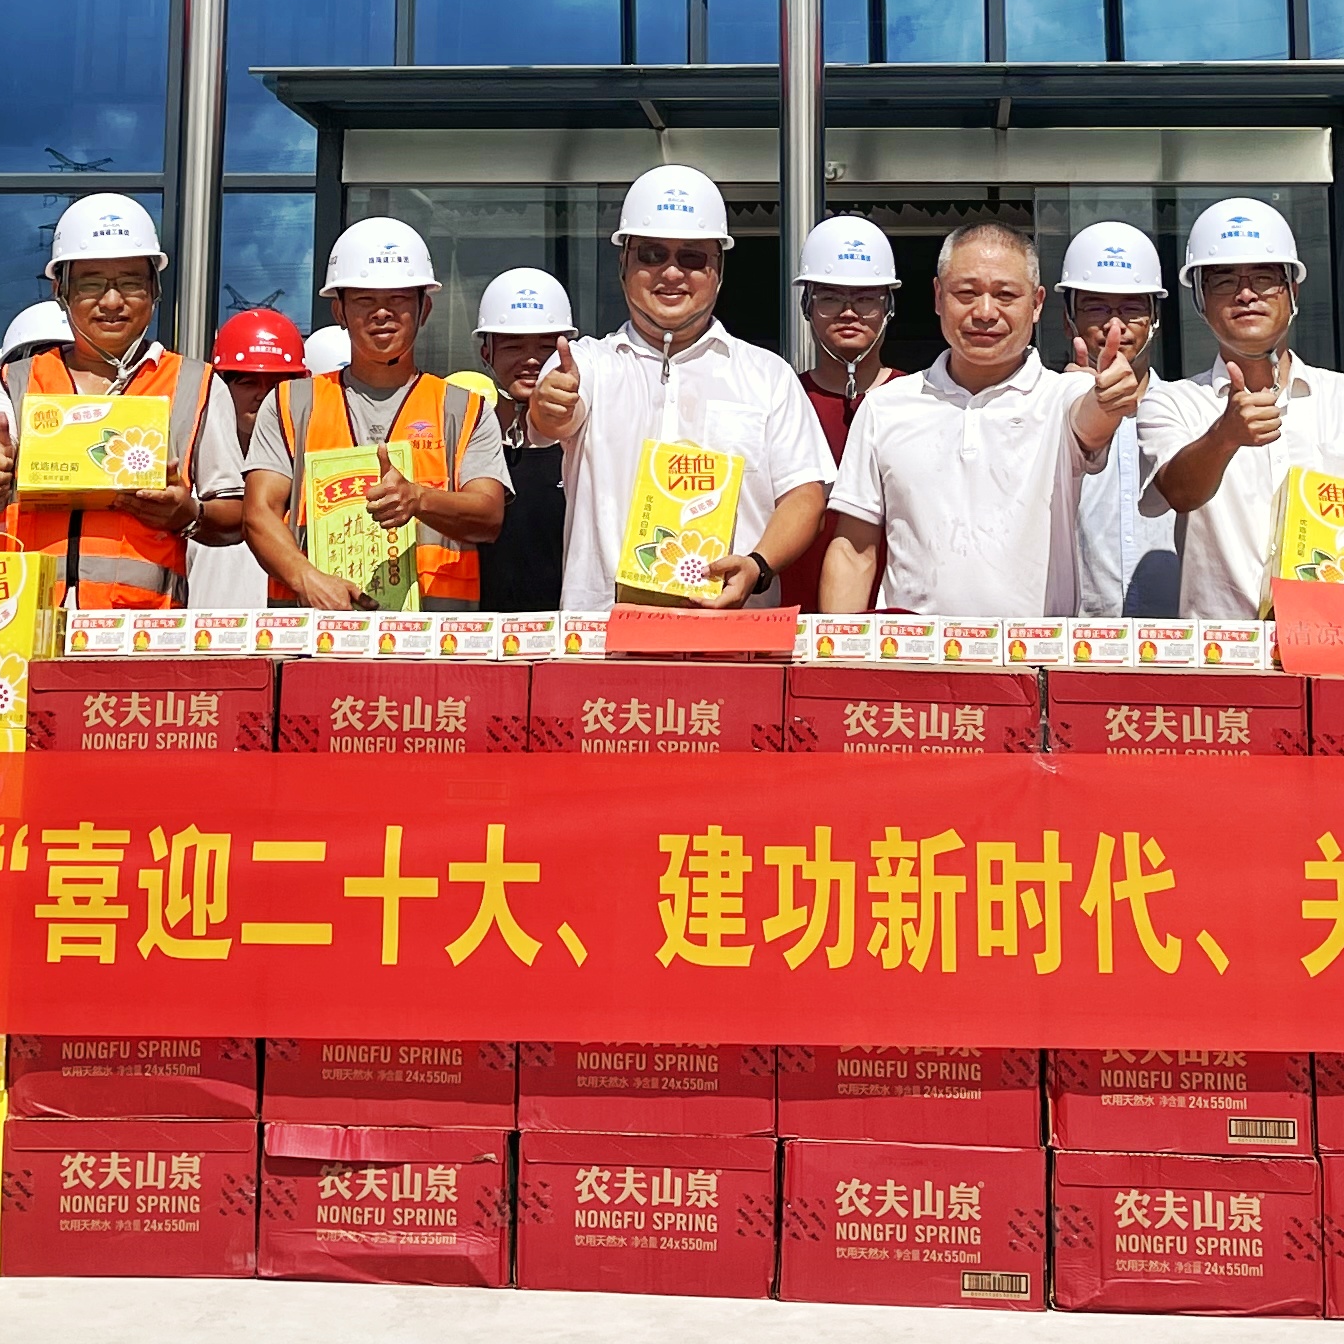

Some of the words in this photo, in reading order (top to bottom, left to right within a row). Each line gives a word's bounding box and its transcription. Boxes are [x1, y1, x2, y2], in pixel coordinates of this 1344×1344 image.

[331, 478, 381, 501] 王老
[83, 691, 222, 727] 农夫山泉
[331, 695, 470, 732] 农夫山泉
[581, 698, 724, 736] 农夫山泉
[844, 701, 988, 741] 农夫山泉
[1105, 705, 1252, 744] 农夫山泉
[82, 733, 148, 749] NONGFU
[156, 733, 217, 749] SPRING
[330, 737, 396, 753] NONGFU
[404, 737, 465, 753] SPRING
[62, 1042, 130, 1059] NONGFU
[138, 1040, 200, 1058] SPRING
[323, 1045, 390, 1063] NONGFU
[399, 1047, 462, 1065] SPRING
[578, 1052, 646, 1070] NONGFU
[655, 1054, 718, 1072] SPRING
[838, 1059, 907, 1078] NONGFU
[916, 1062, 981, 1080] SPRING
[1101, 1070, 1172, 1088] NONGFU
[1180, 1072, 1246, 1090] SPRING
[60, 1152, 204, 1189] 农夫山泉
[318, 1164, 461, 1202] 农夫山泉
[575, 1166, 721, 1208] 农夫山泉
[60, 1196, 128, 1212] NONGFU
[137, 1196, 200, 1213] SPRING
[835, 1178, 984, 1220] 农夫山泉
[317, 1205, 385, 1225] NONGFU
[393, 1208, 456, 1226] SPRING
[576, 1210, 644, 1229] NONGFU
[653, 1213, 717, 1232] SPRING
[1115, 1189, 1264, 1232] 农夫山泉
[837, 1222, 906, 1242] NONGFU
[915, 1225, 980, 1244] SPRING
[1116, 1235, 1187, 1254] NONGFU
[1196, 1237, 1262, 1256] SPRING
